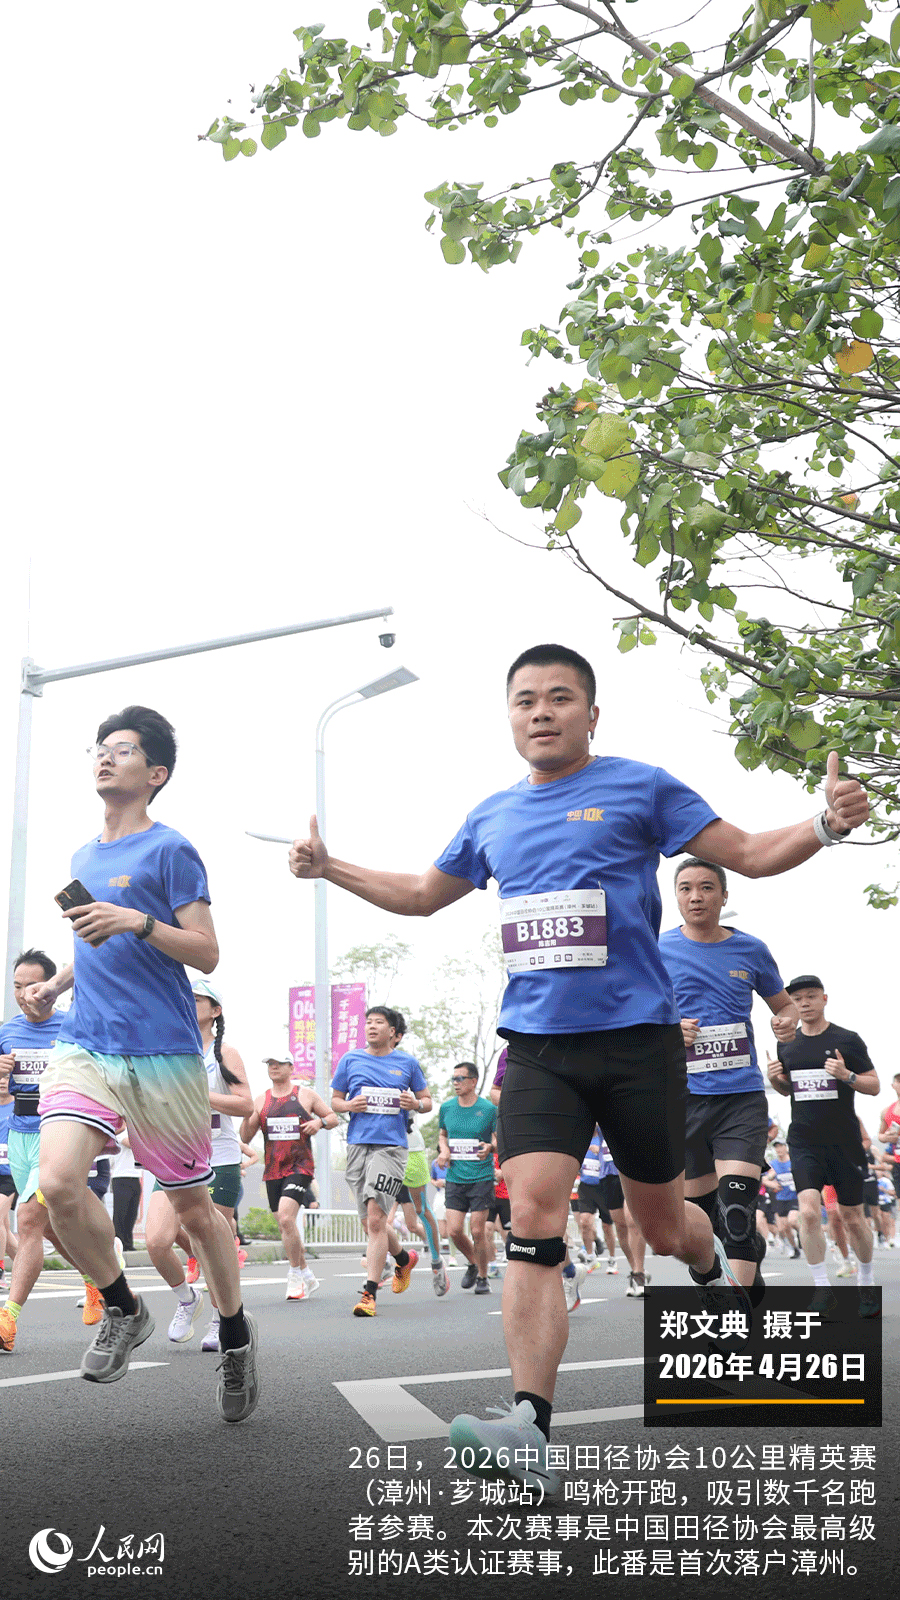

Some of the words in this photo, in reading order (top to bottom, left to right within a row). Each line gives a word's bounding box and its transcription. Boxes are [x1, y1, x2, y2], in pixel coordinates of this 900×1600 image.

[583, 807, 605, 822] 10K
[516, 916, 584, 943] B1883
[293, 1000, 315, 1021] 04
[293, 1042, 316, 1062] 26
[694, 1039, 739, 1056] B2071
[797, 1079, 829, 1090] B2574
